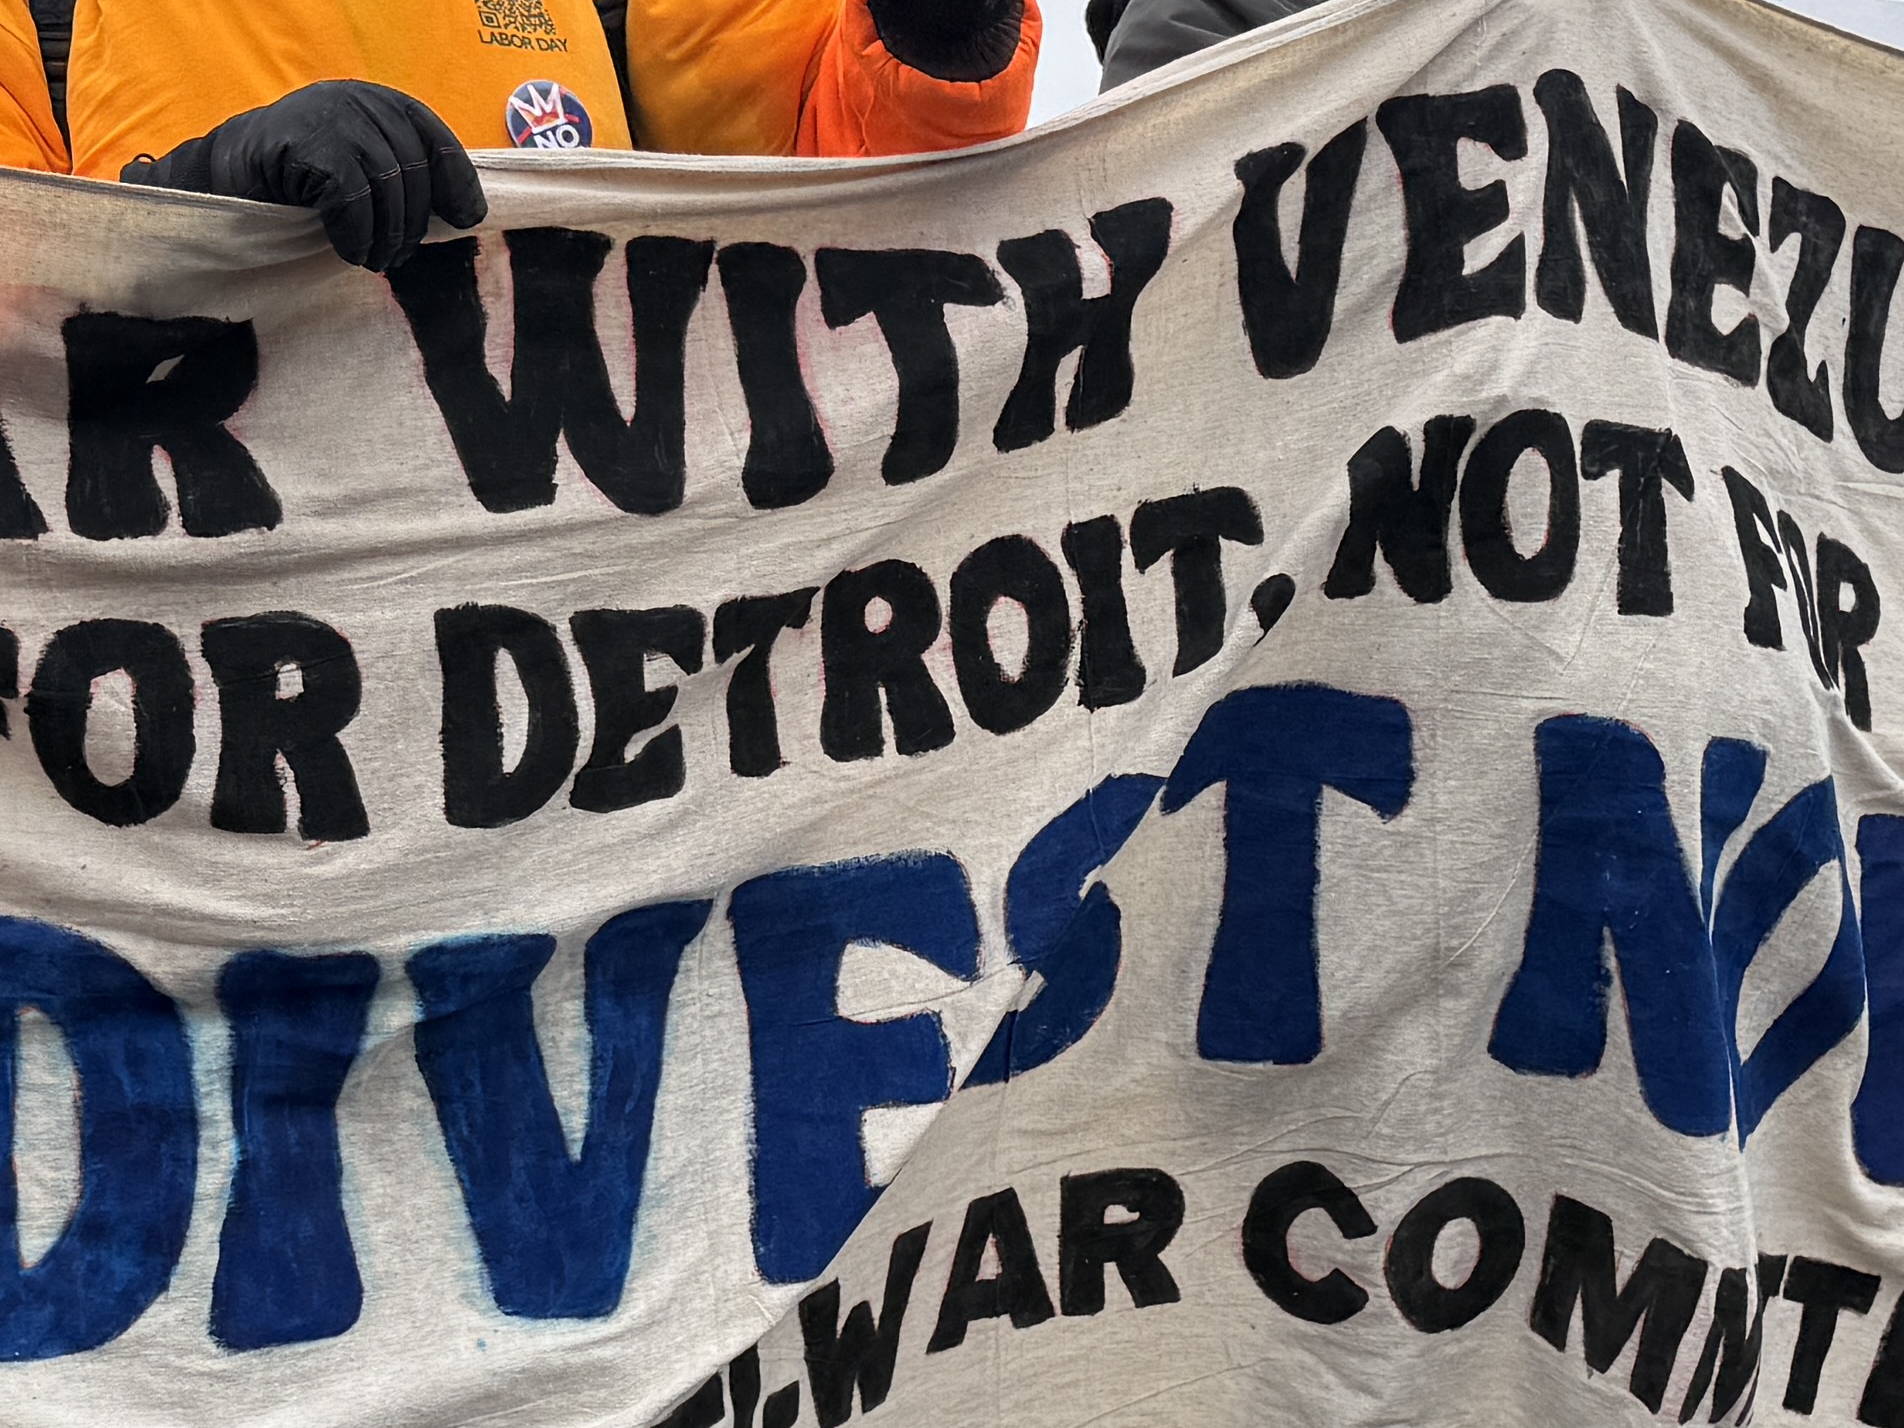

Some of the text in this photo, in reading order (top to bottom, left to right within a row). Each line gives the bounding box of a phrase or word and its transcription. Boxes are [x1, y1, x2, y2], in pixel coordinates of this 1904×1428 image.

[477, 29, 569, 53] LABOR DAY
[533, 124, 580, 148] NO
[383, 196, 1175, 516] WITH
[434, 485, 1296, 830] DETROIT,
[1322, 409, 1695, 617] NOT
[1720, 465, 1883, 733] FOR
